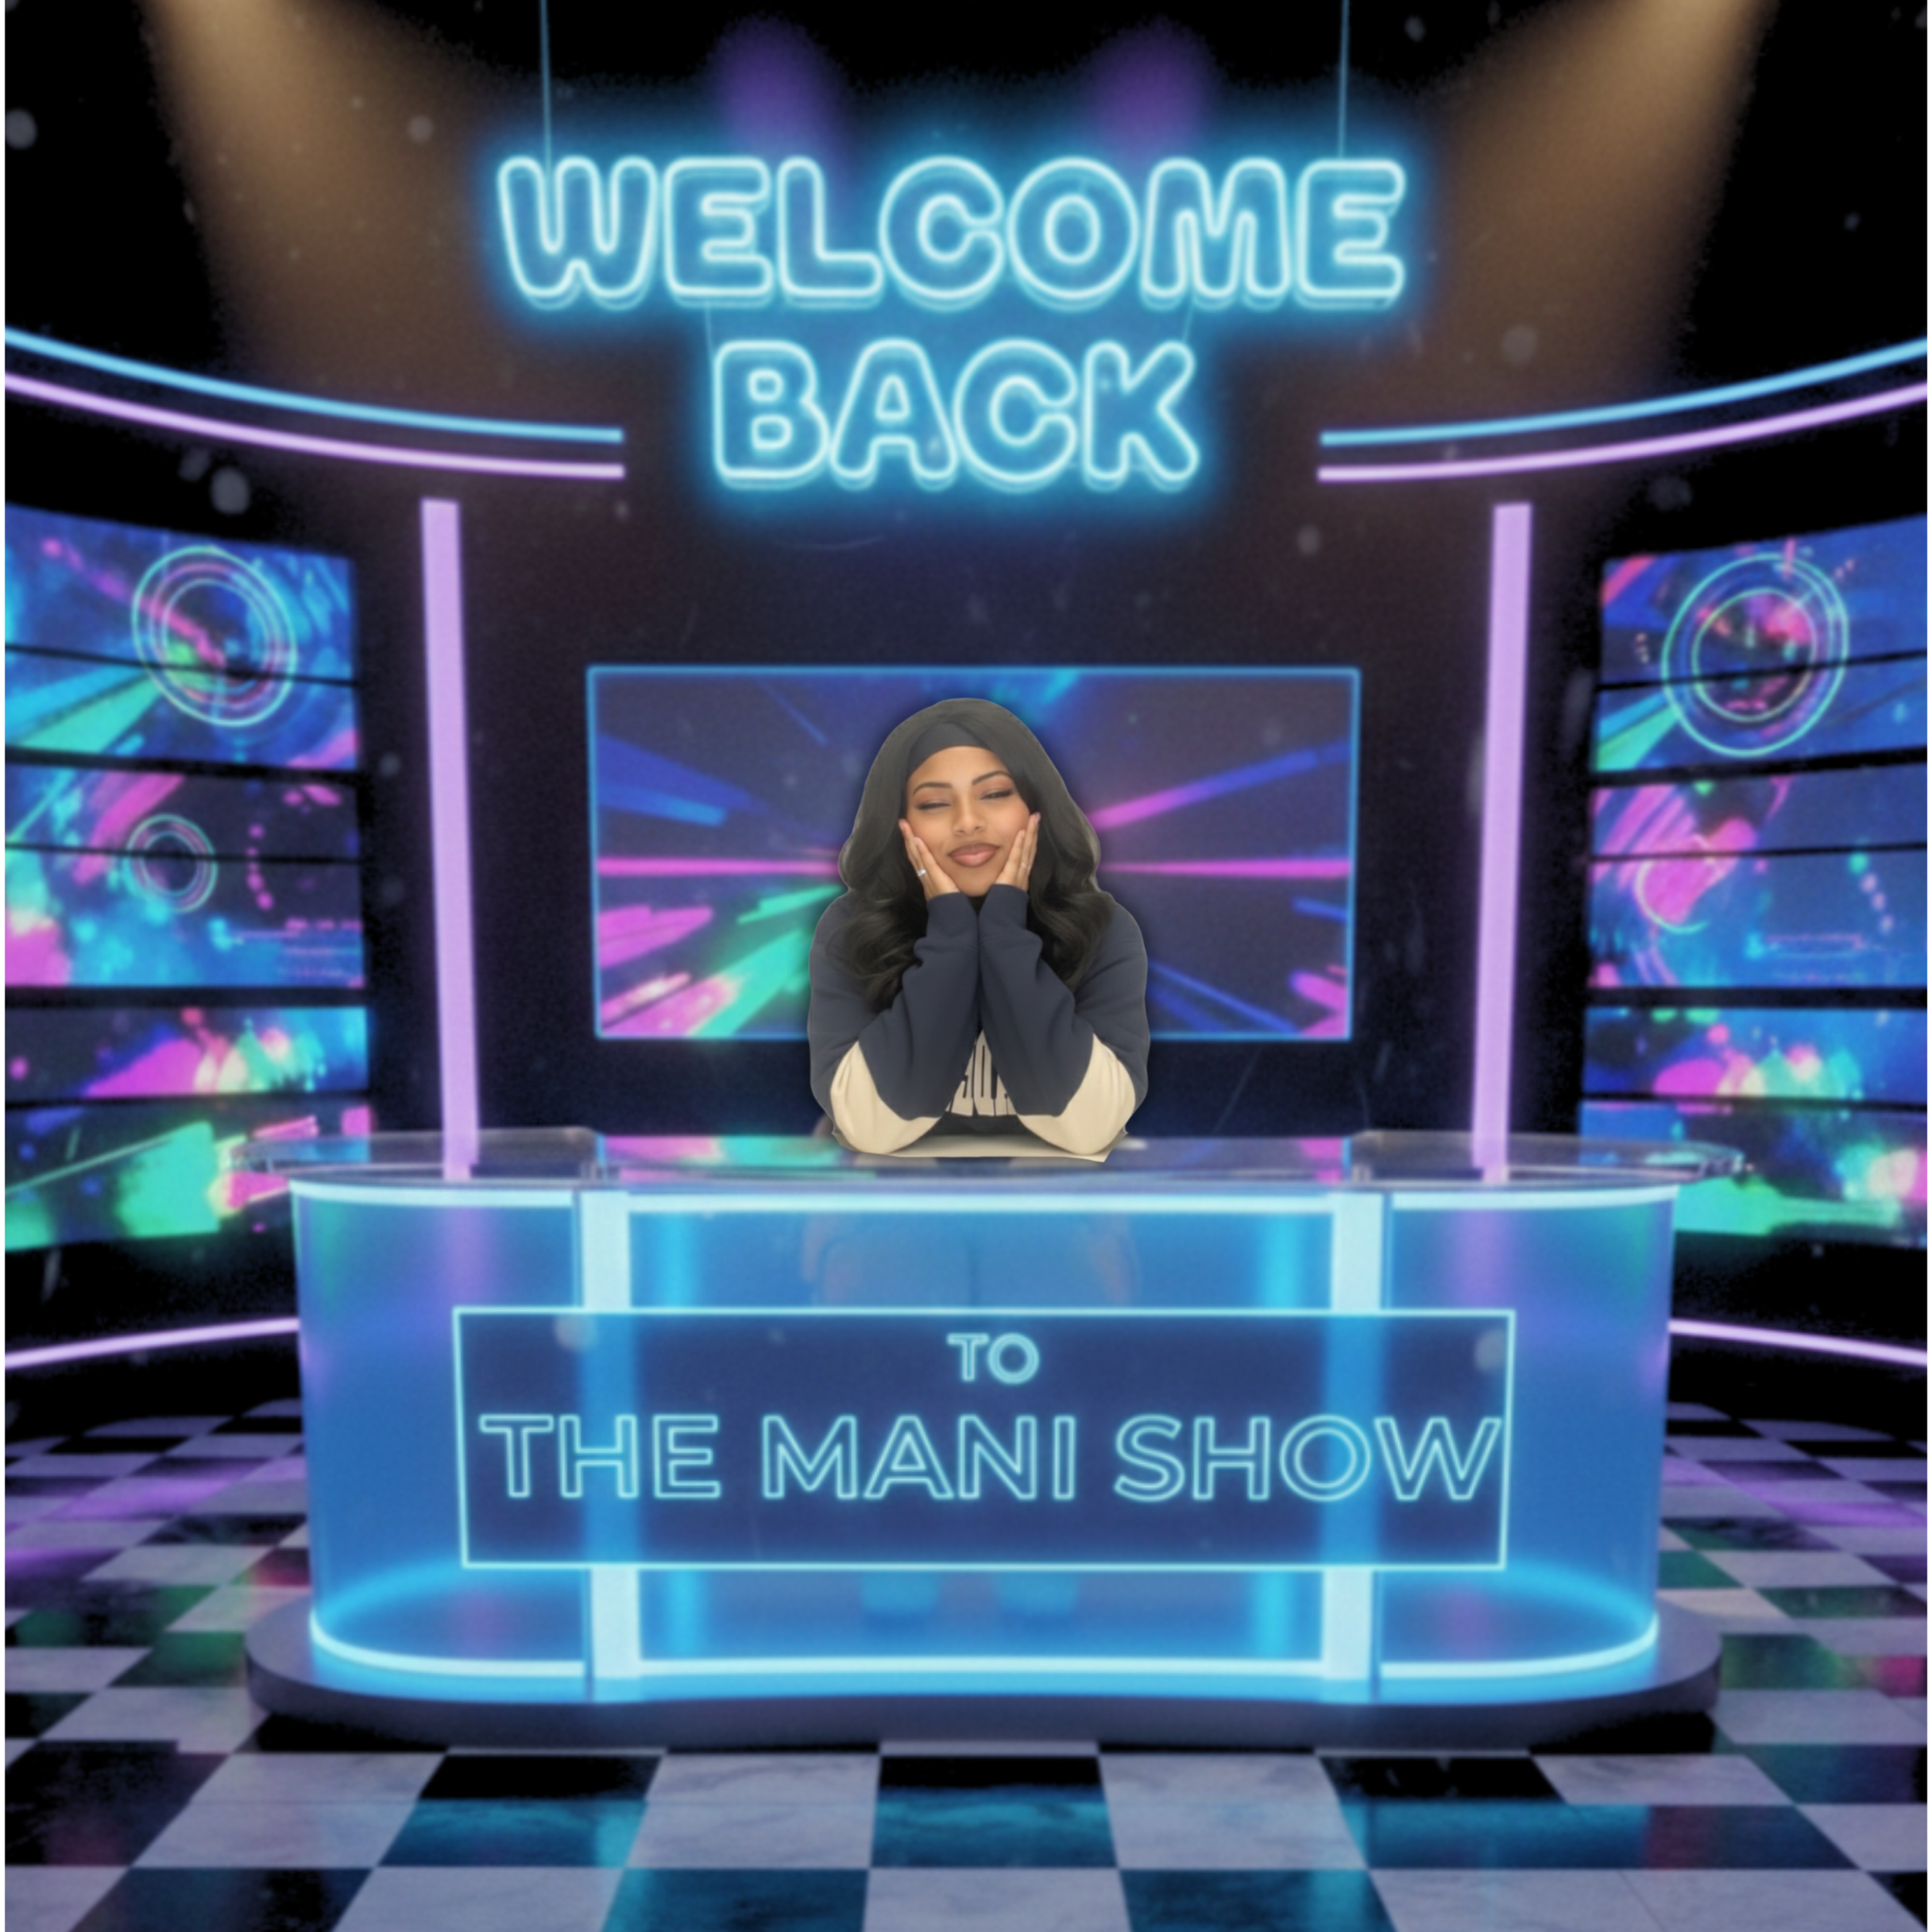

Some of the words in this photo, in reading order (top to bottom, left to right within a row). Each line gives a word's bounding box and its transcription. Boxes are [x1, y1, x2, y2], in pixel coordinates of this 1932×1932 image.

[497, 155, 1407, 308] WELCOME
[711, 338, 1200, 491] BACK
[947, 1332, 1041, 1385] TO
[478, 1413, 722, 1501] THE
[760, 1414, 1077, 1502] MANI
[1113, 1413, 1502, 1502] SHOW
